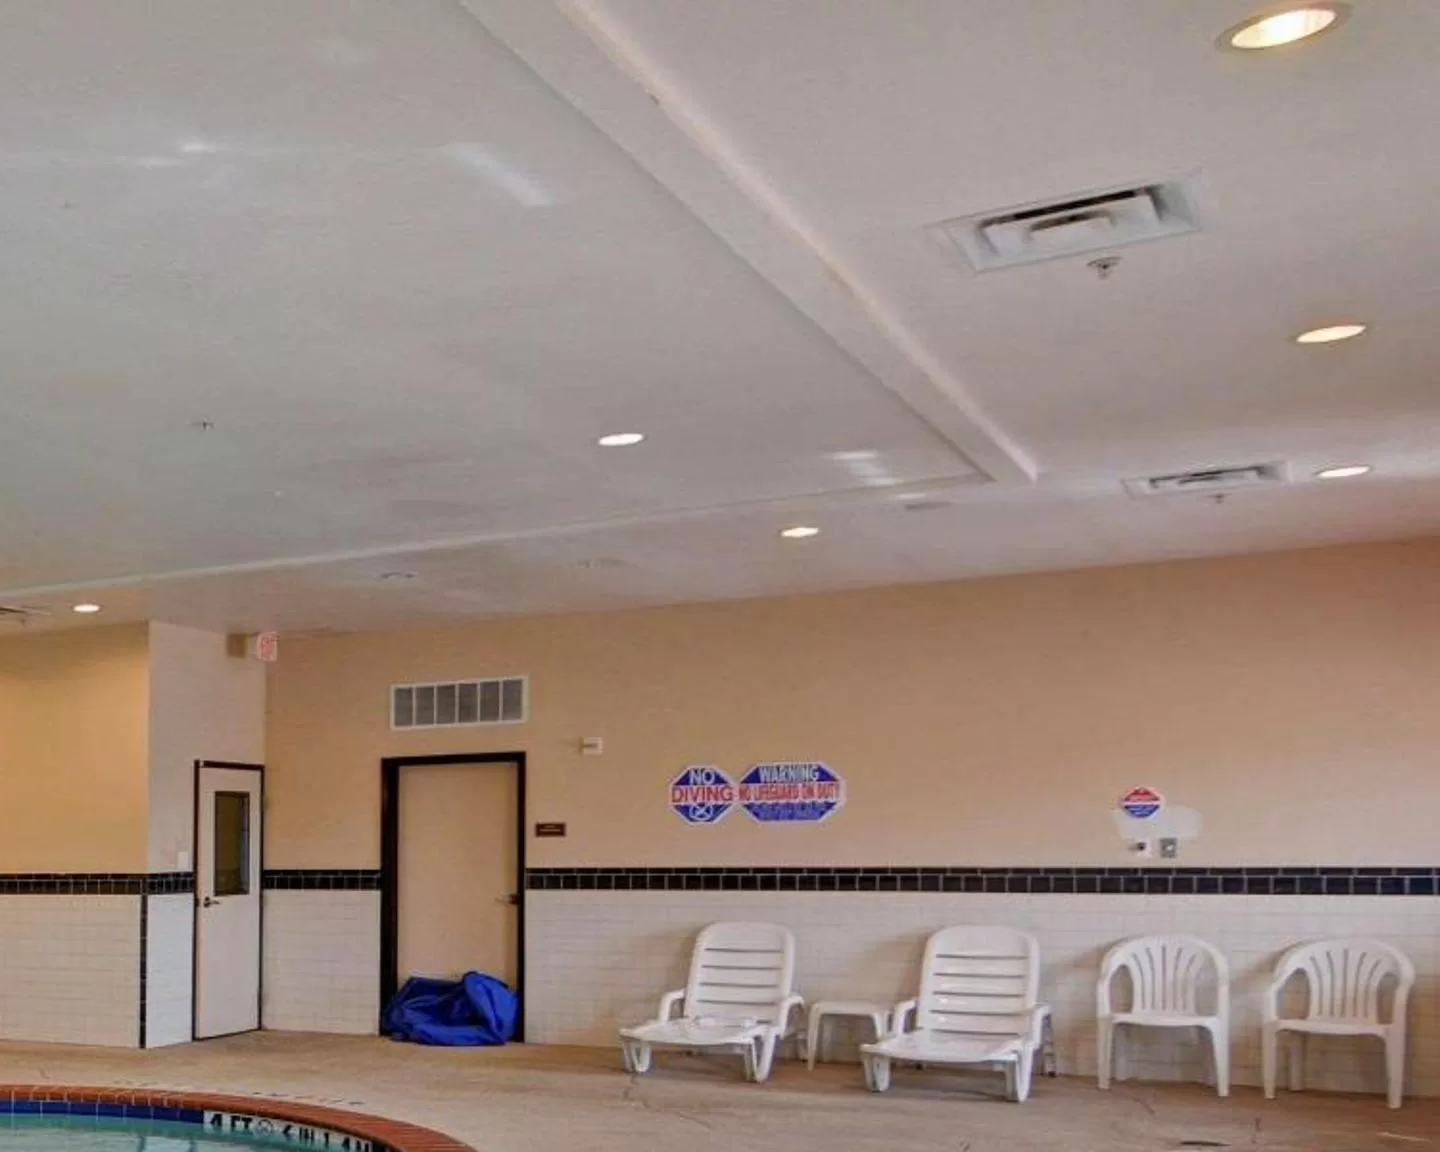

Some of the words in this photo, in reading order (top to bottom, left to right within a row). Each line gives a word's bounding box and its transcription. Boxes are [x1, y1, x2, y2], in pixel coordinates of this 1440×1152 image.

[689, 768, 715, 785] NO
[760, 765, 819, 783] WARNING
[671, 786, 733, 803] DIVING
